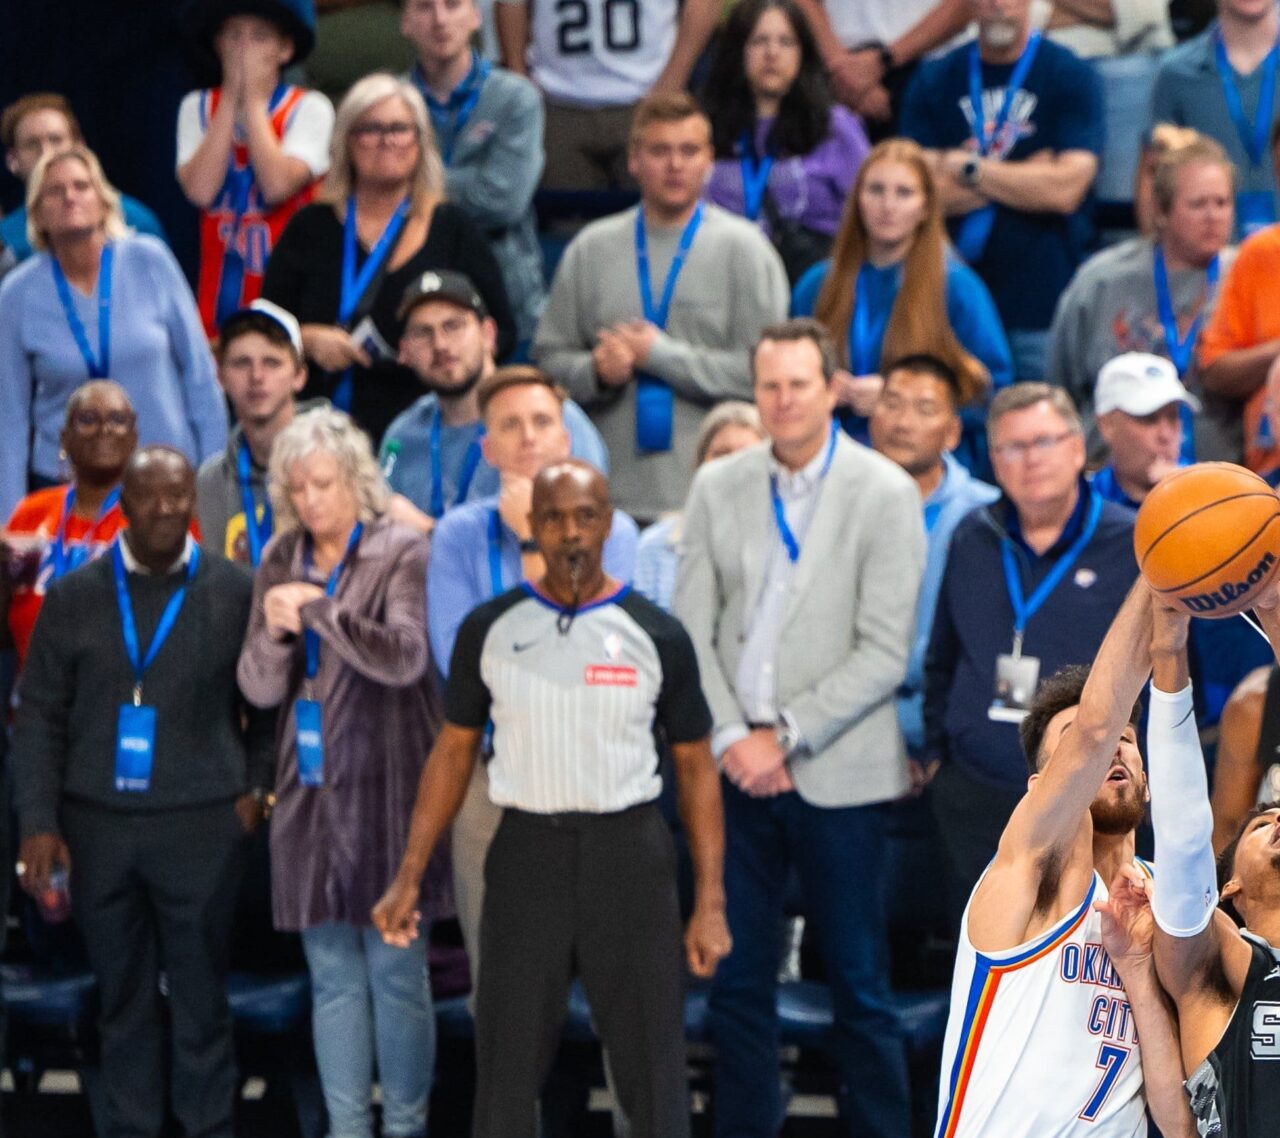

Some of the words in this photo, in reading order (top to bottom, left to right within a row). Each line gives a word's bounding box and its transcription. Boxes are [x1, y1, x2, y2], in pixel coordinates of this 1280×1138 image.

[555, 0, 641, 54] 20
[1178, 551, 1277, 613] Wilson
[1087, 995, 1140, 1045] CIT
[1078, 1041, 1131, 1121] 7
